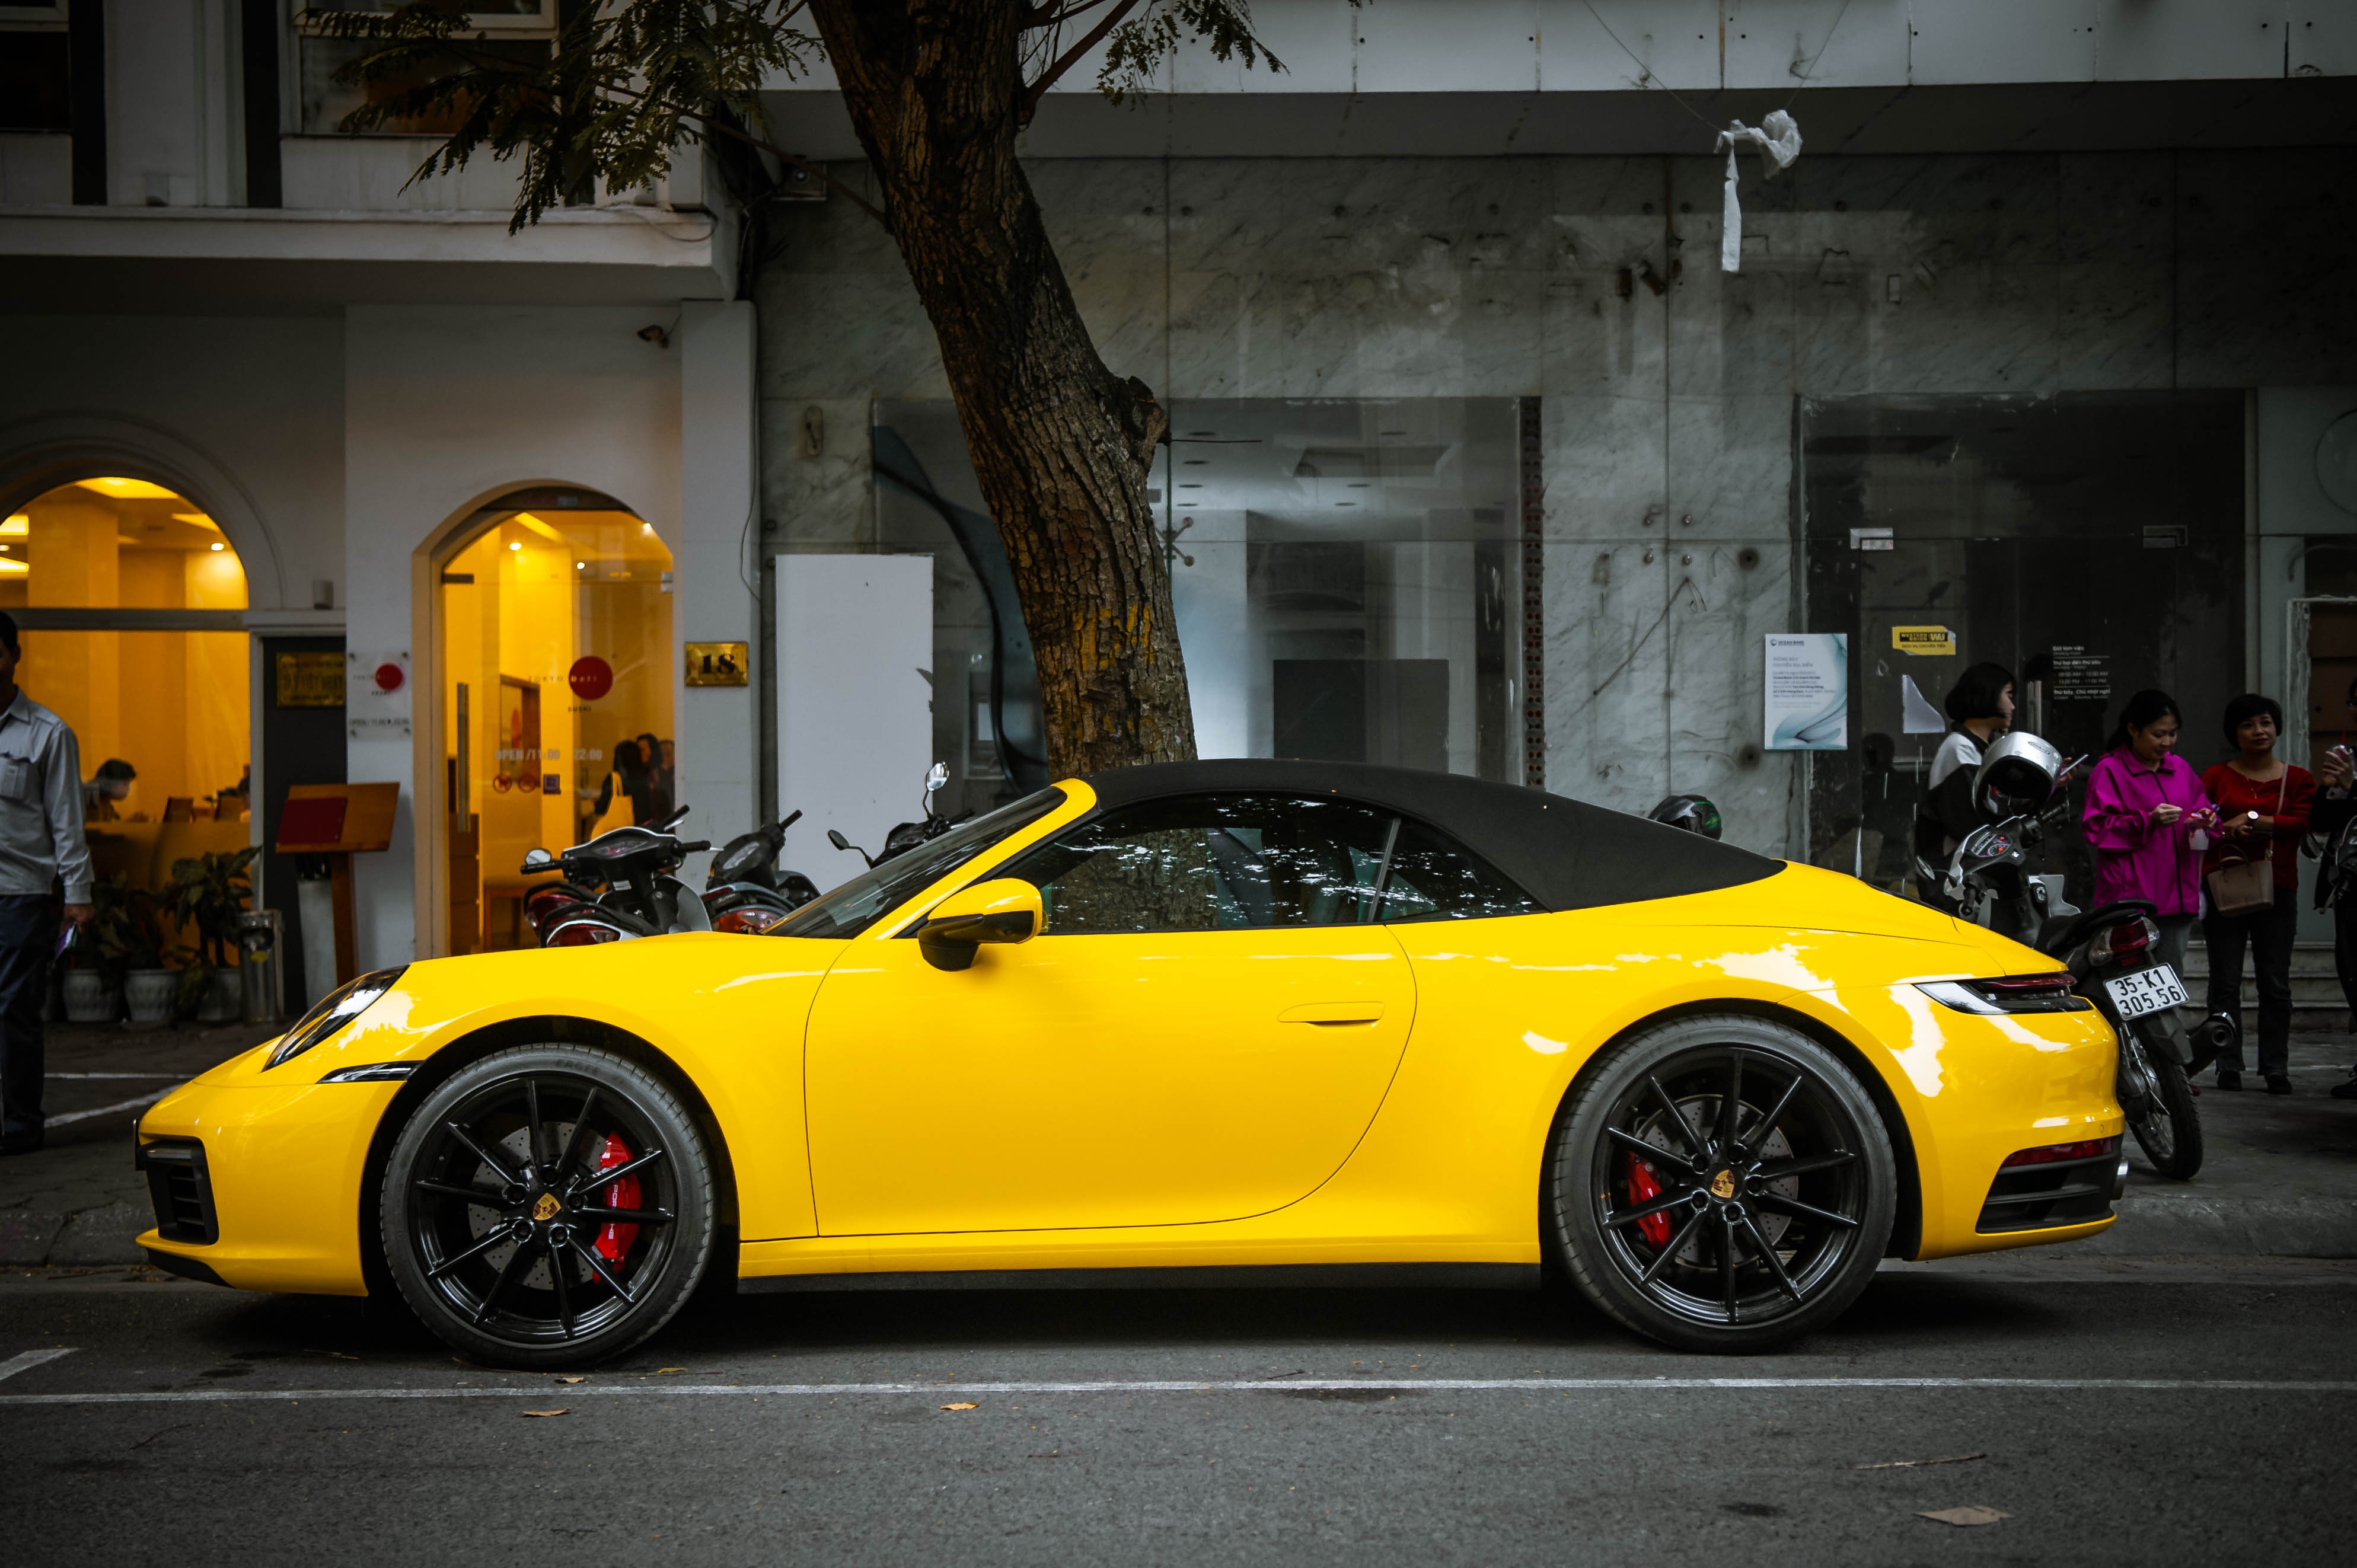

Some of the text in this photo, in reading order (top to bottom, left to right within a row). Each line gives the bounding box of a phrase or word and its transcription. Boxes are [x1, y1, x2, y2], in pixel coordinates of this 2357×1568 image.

[701, 653, 735, 674] 18
[495, 749, 523, 761] OPEN
[2114, 969, 2165, 996] 35-K1
[2119, 985, 2181, 1015] 305.56
[608, 1184, 618, 1240] PORHE
